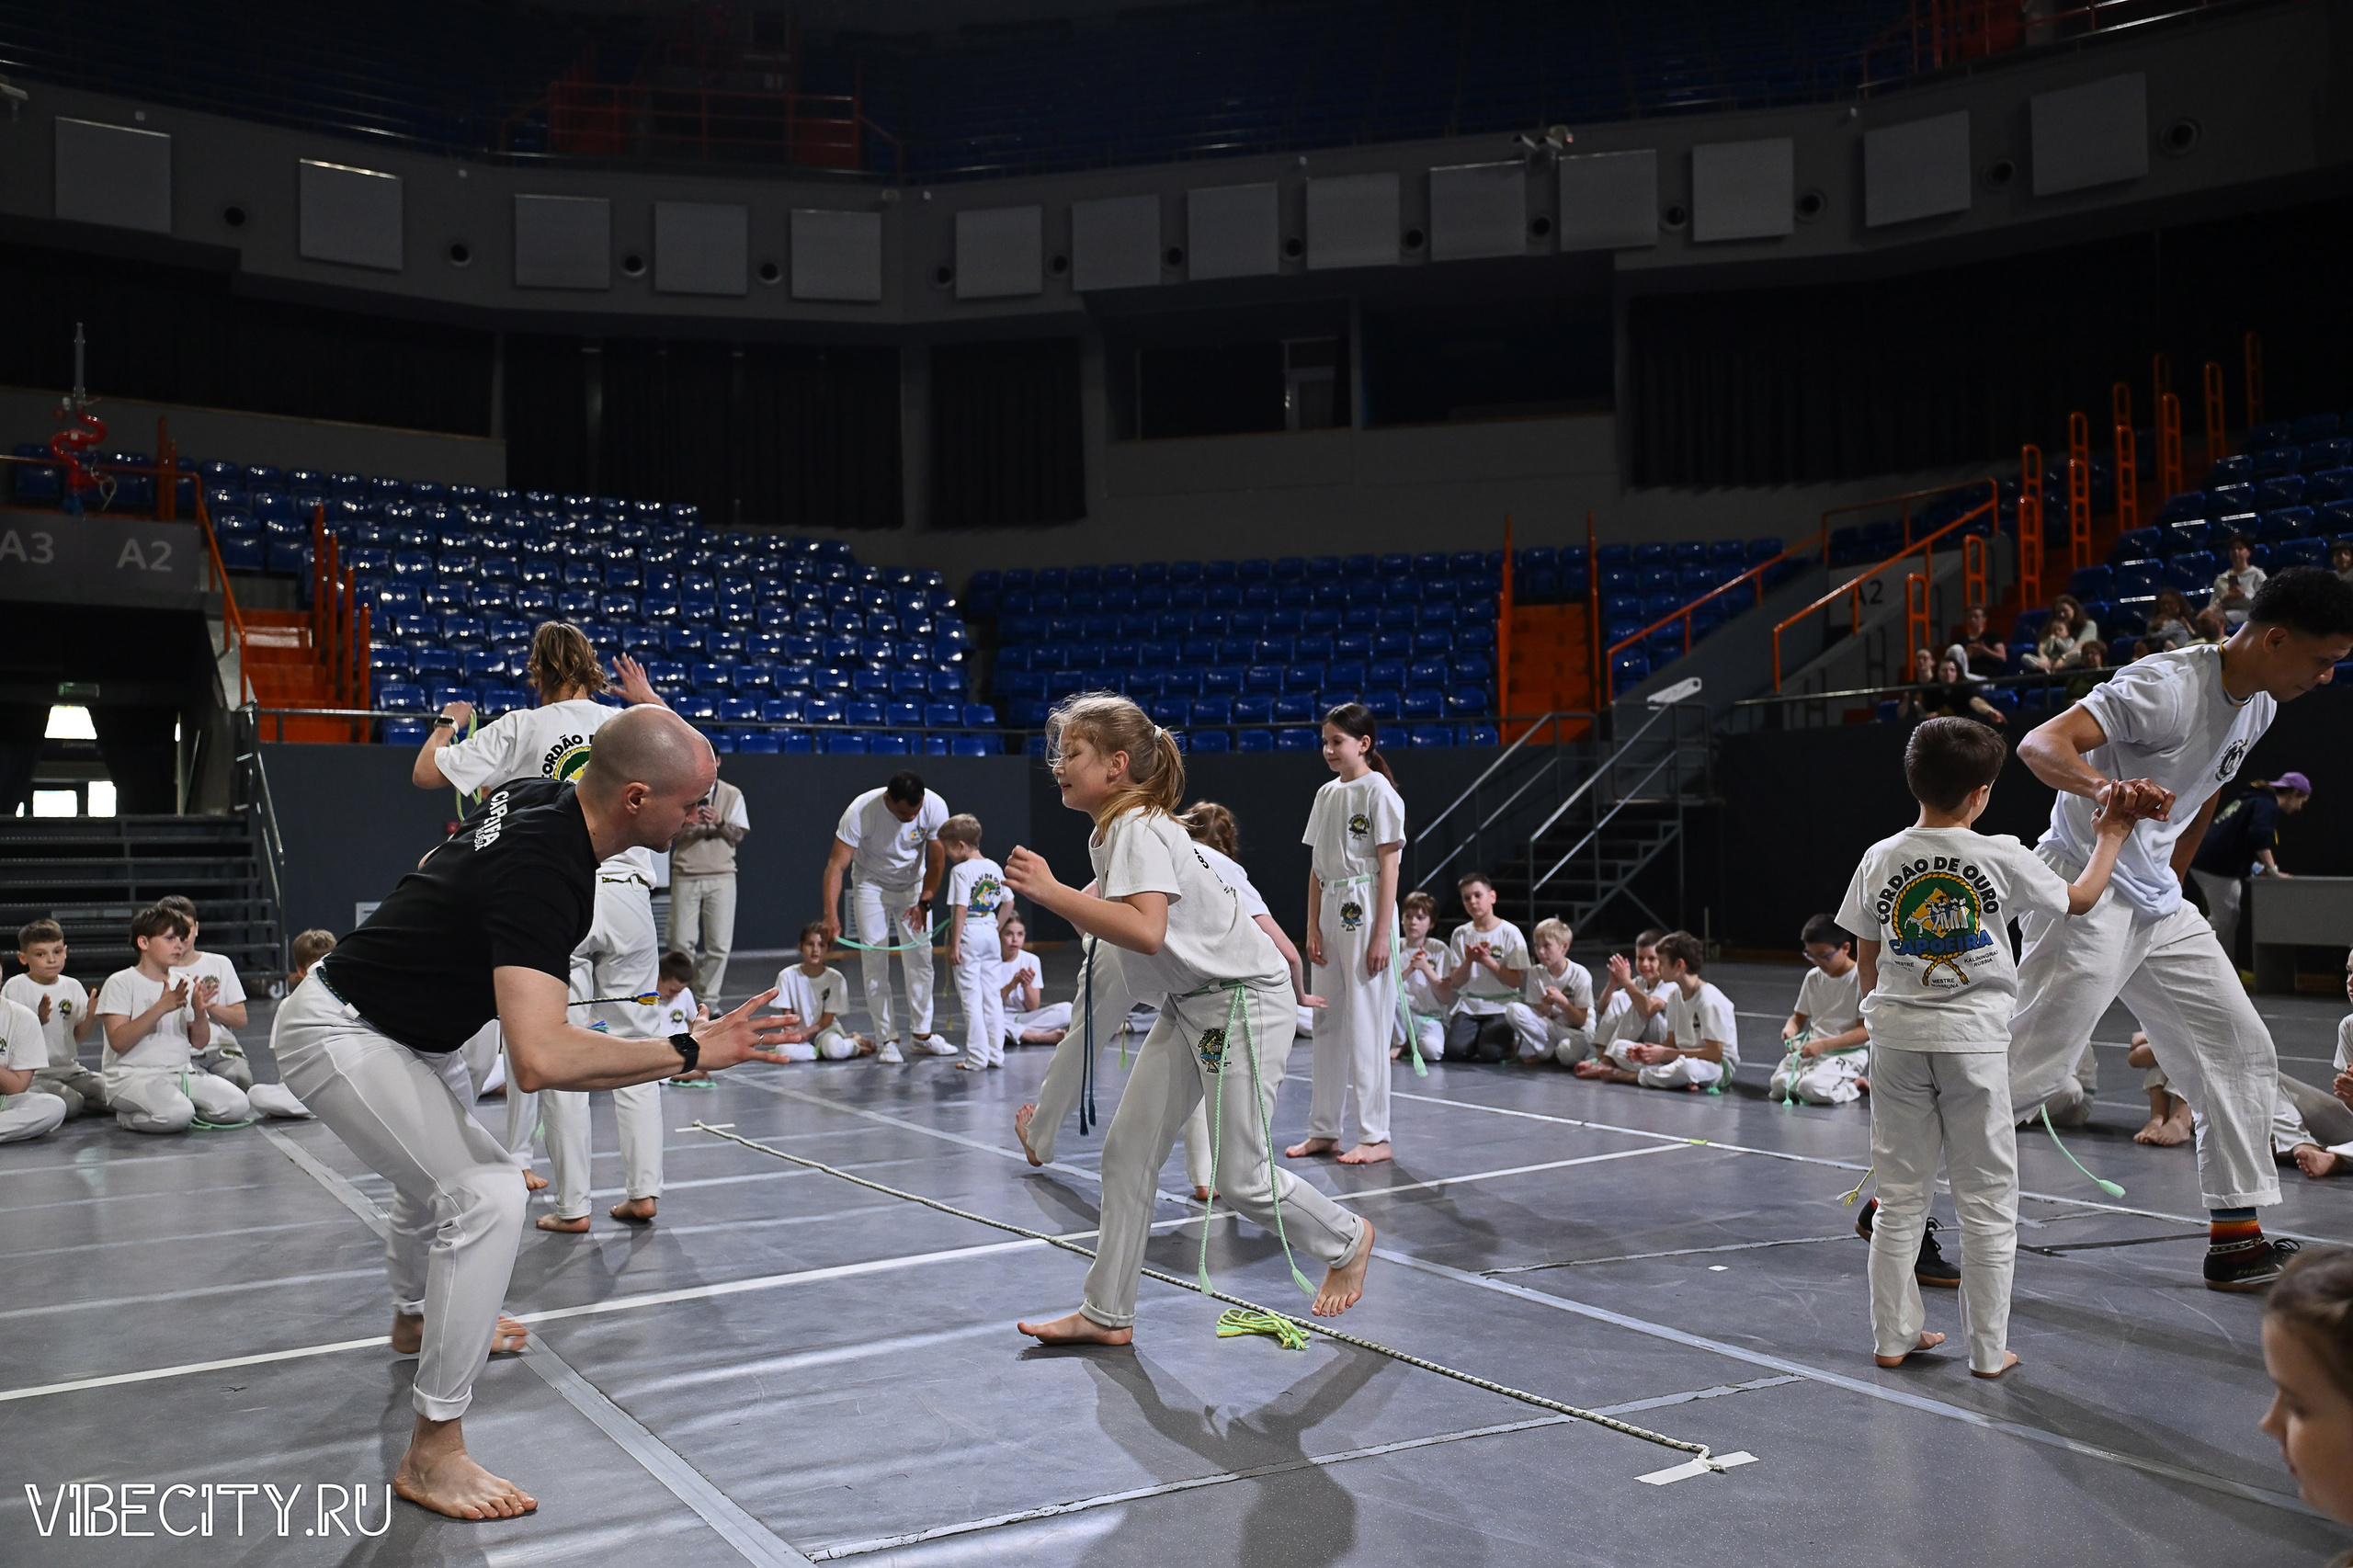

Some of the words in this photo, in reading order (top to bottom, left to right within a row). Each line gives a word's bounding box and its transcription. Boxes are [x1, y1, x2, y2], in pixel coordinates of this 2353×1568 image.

[0, 529, 54, 564] A3
[116, 538, 173, 572] A2
[540, 733, 584, 778] ORDÃO
[1876, 858, 1929, 925] CORDÃO
[1933, 856, 1961, 873] DE
[1962, 865, 1999, 915] OURO
[1888, 929, 1995, 956] CAPOEIRA
